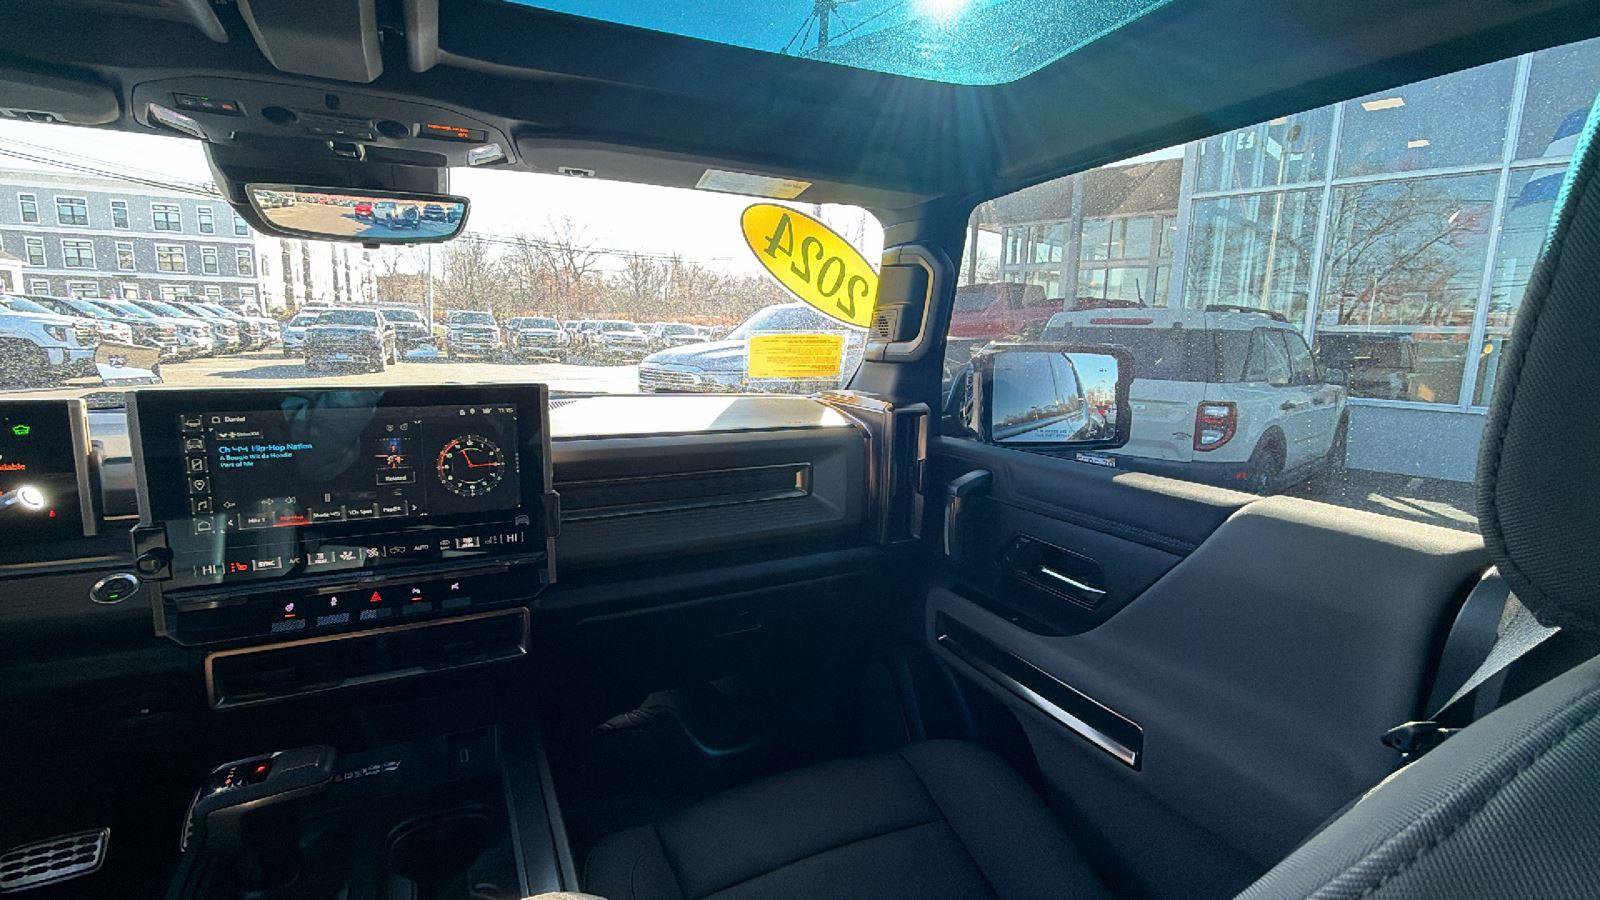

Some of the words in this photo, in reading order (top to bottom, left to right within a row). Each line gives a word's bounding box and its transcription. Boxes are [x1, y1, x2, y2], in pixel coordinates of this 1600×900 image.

[218, 445, 231, 454] Ch
[251, 443, 286, 453] Hip-Hop
[287, 442, 313, 450] Nation
[506, 532, 518, 543] HI
[257, 559, 276, 568] SYNC
